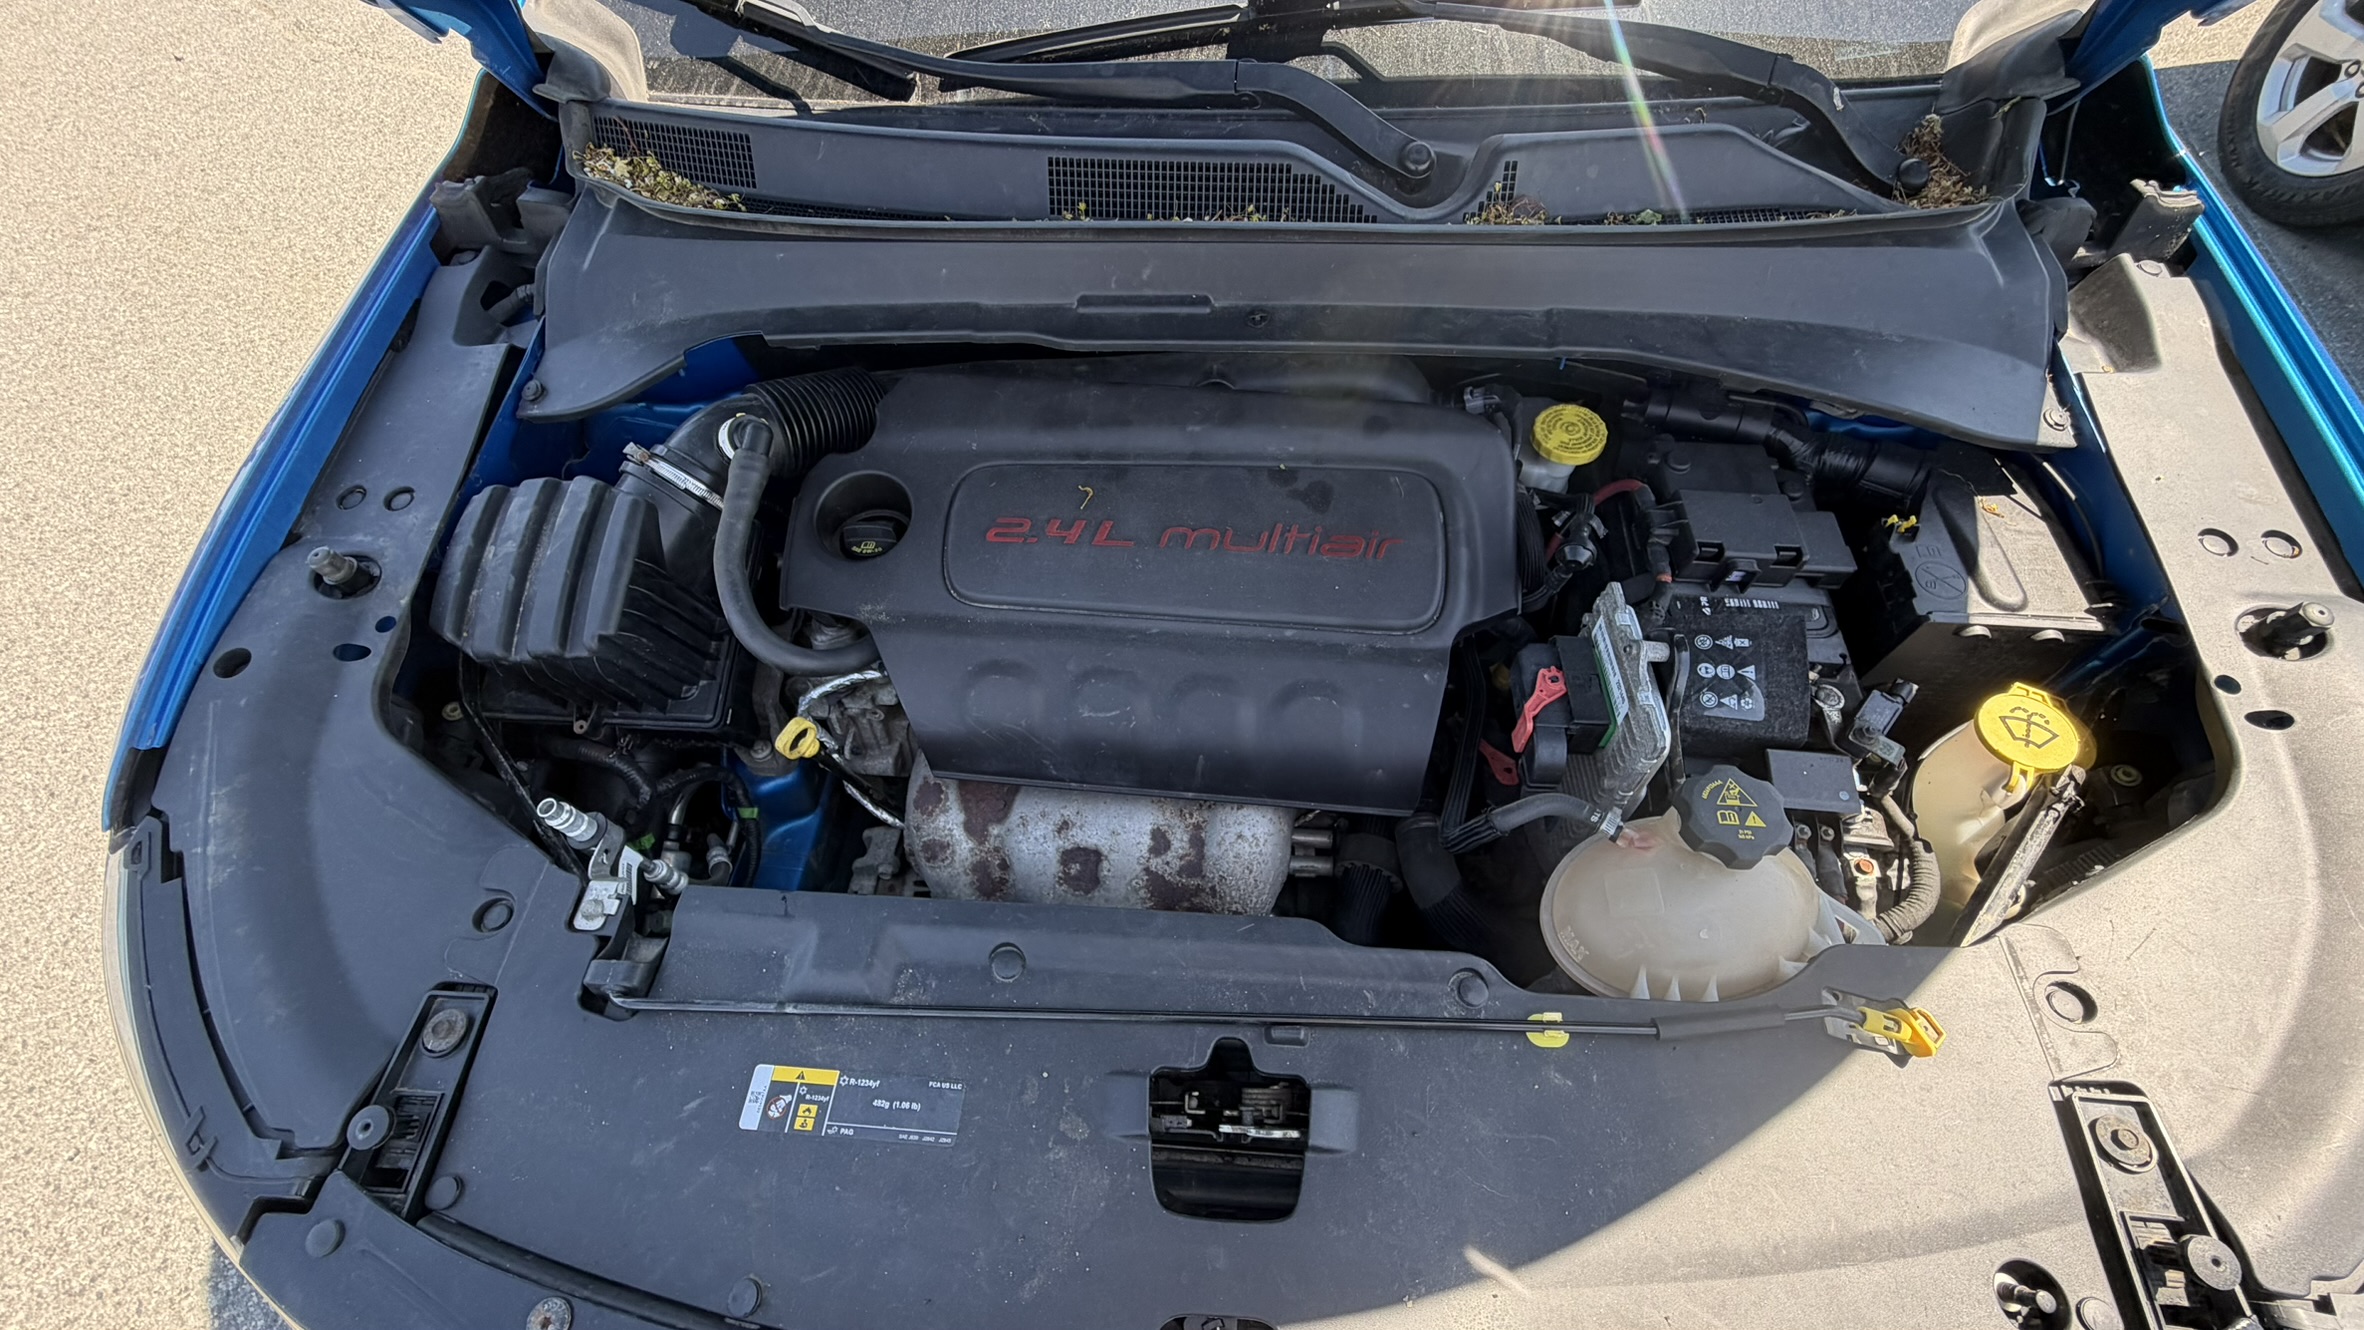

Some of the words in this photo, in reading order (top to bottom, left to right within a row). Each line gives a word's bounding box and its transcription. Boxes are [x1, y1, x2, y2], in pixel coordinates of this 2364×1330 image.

[1159, 522, 1405, 560] multiair
[848, 1079, 881, 1089] R-1234yf
[950, 1082, 963, 1090] LLC
